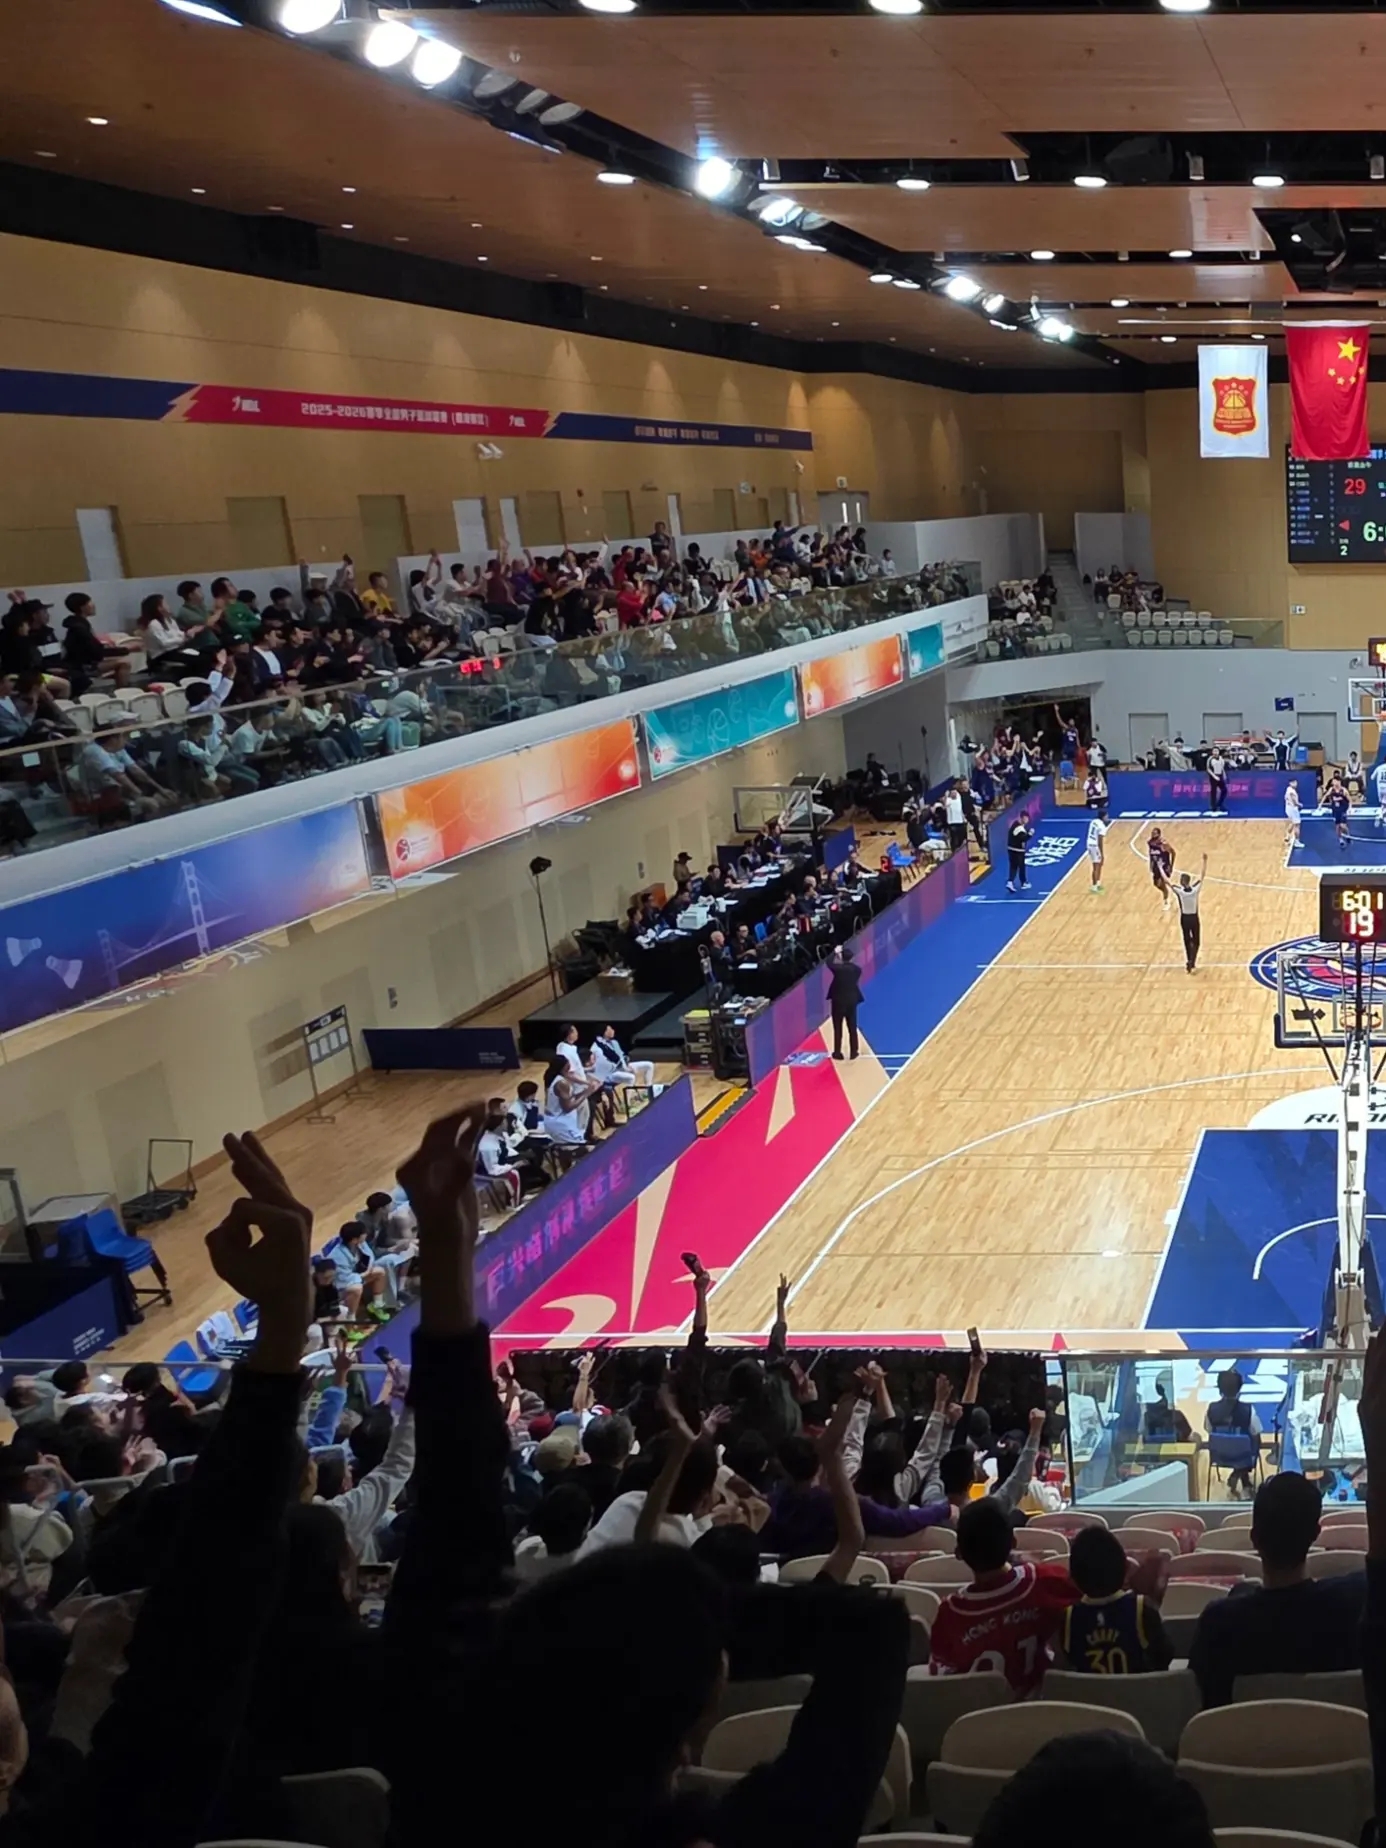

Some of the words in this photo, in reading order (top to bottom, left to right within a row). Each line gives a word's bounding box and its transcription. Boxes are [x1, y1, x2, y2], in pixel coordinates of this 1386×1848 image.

[1344, 478, 1366, 495] 29
[1340, 545, 1348, 556] 2
[1350, 909, 1374, 937] 19
